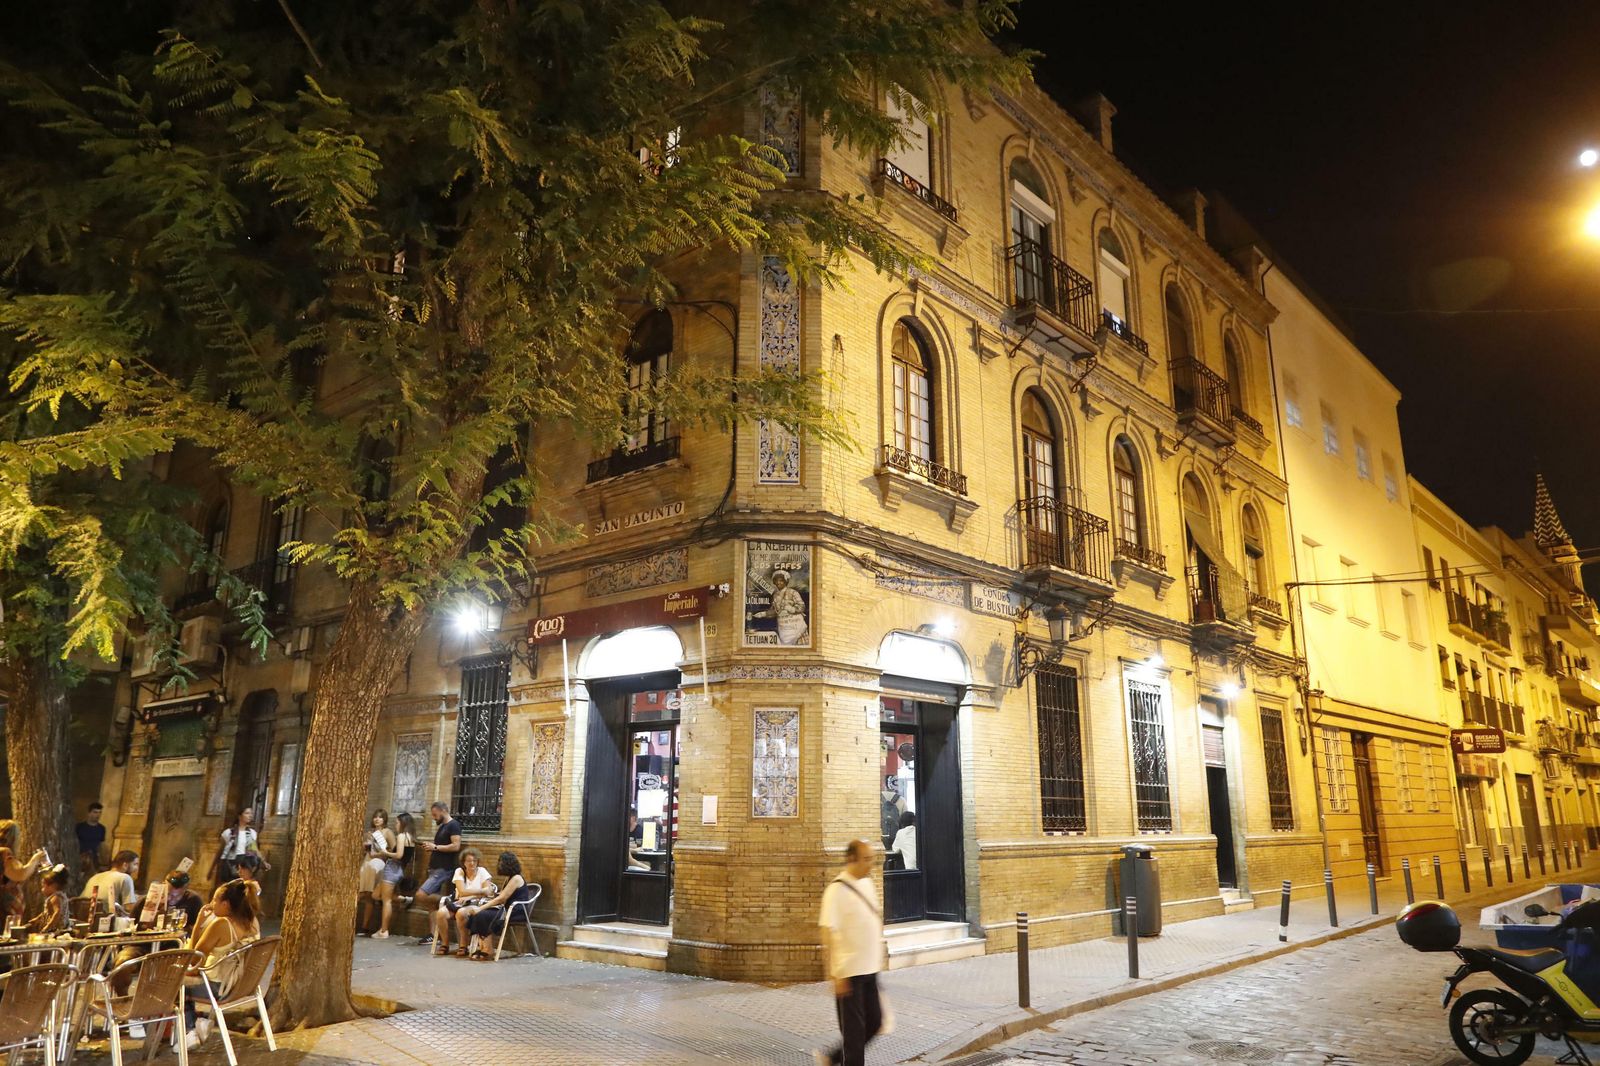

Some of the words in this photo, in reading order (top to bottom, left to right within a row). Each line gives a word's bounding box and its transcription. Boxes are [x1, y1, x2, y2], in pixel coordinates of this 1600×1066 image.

[595, 519, 619, 533] SAN
[625, 502, 682, 527] JACINTO
[983, 588, 1011, 603] CONDES
[974, 596, 984, 608] DE
[987, 600, 1020, 618] BUSTILLO
[540, 618, 559, 632] 100
[769, 635, 778, 645] 20
